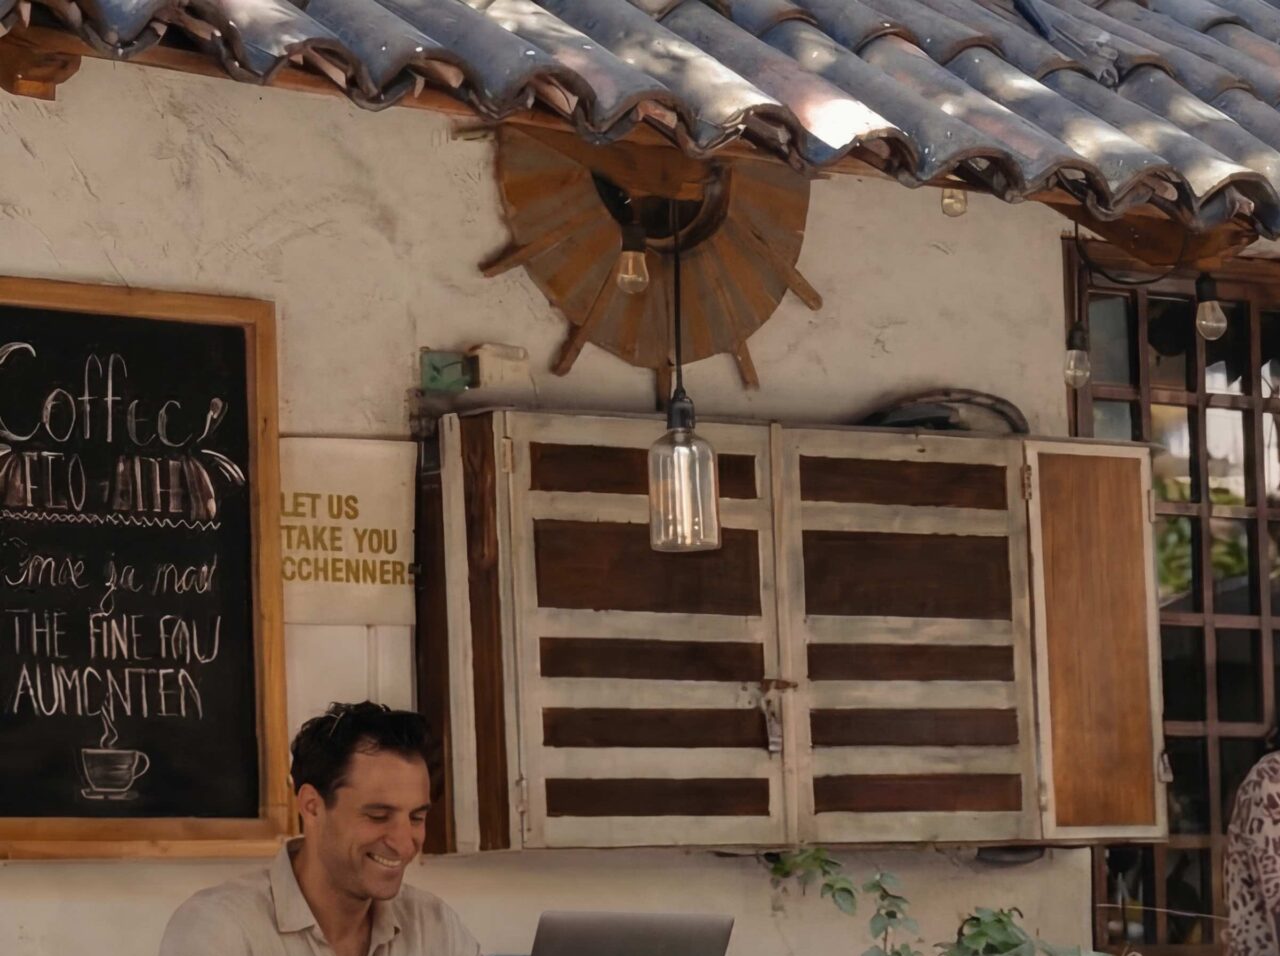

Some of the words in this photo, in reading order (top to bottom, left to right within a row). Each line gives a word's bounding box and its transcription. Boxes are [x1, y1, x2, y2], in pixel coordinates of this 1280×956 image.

[280, 492, 321, 518] LET
[328, 494, 359, 520] US
[280, 525, 343, 551] TAKE
[353, 527, 397, 554] YOU
[281, 556, 415, 586] CCHENNER
[5, 608, 68, 658] THE
